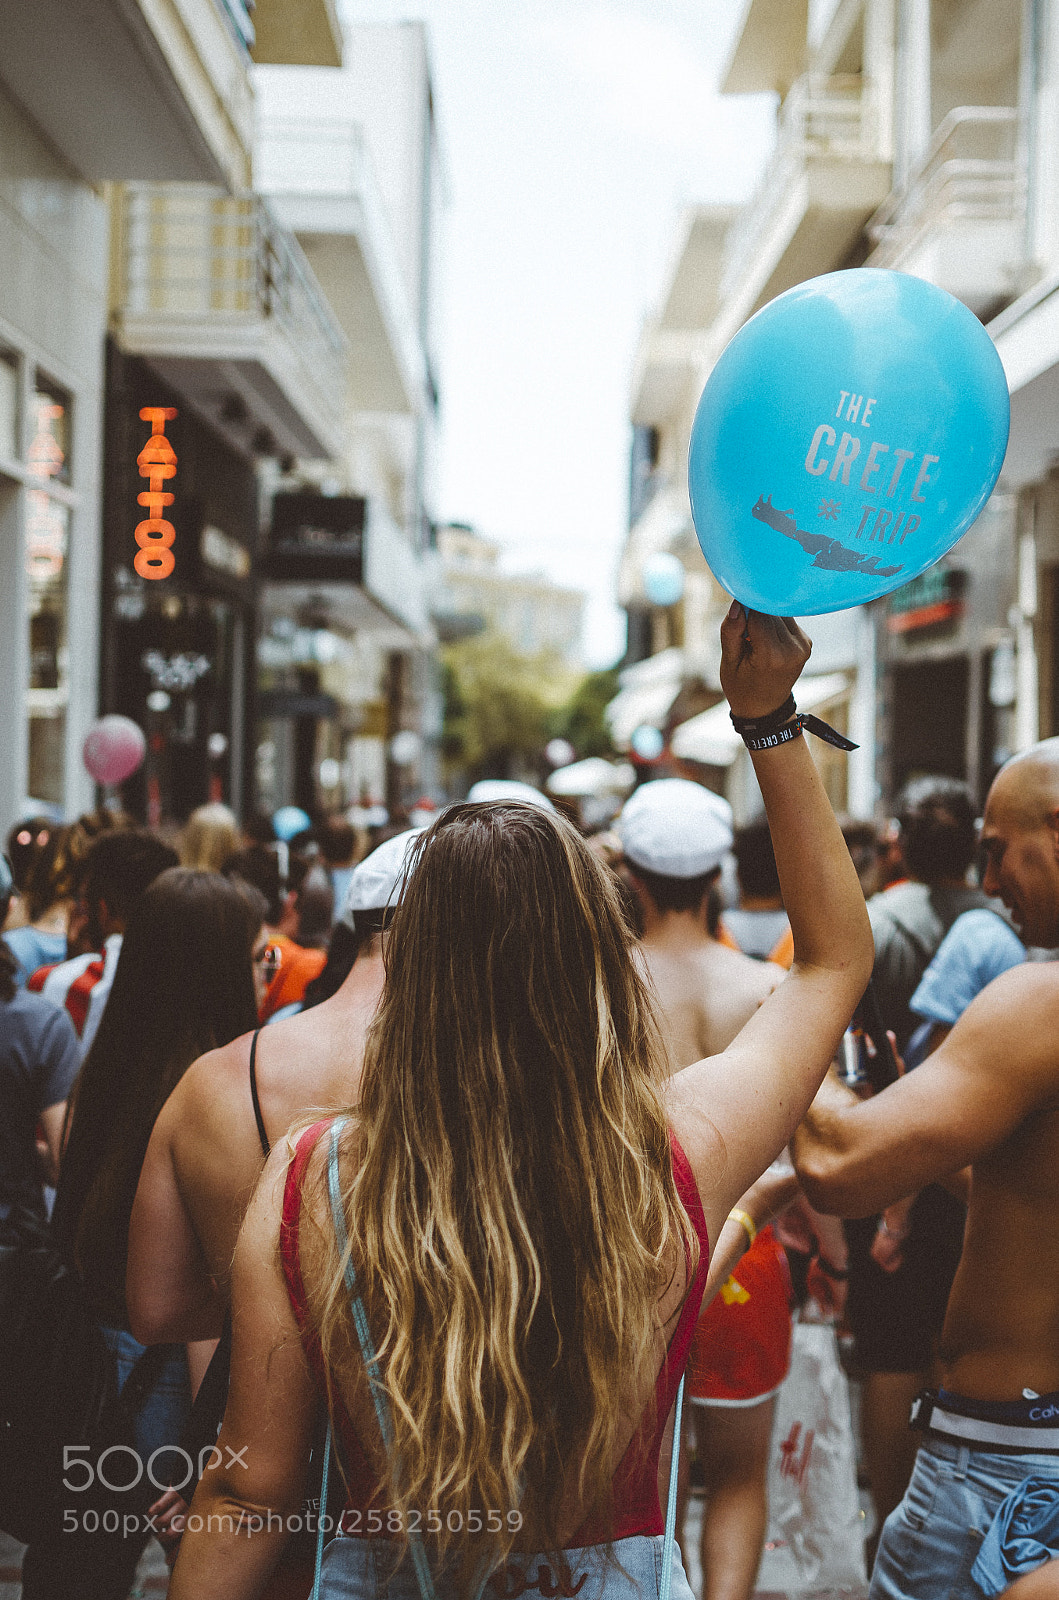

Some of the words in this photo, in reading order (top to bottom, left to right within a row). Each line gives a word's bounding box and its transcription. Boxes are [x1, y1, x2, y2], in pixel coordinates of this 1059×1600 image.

[835, 390, 877, 427] THE
[805, 424, 940, 503] CRETE
[134, 407, 178, 580] TATTOO
[853, 504, 922, 545] TRIP
[779, 728, 793, 742] THE
